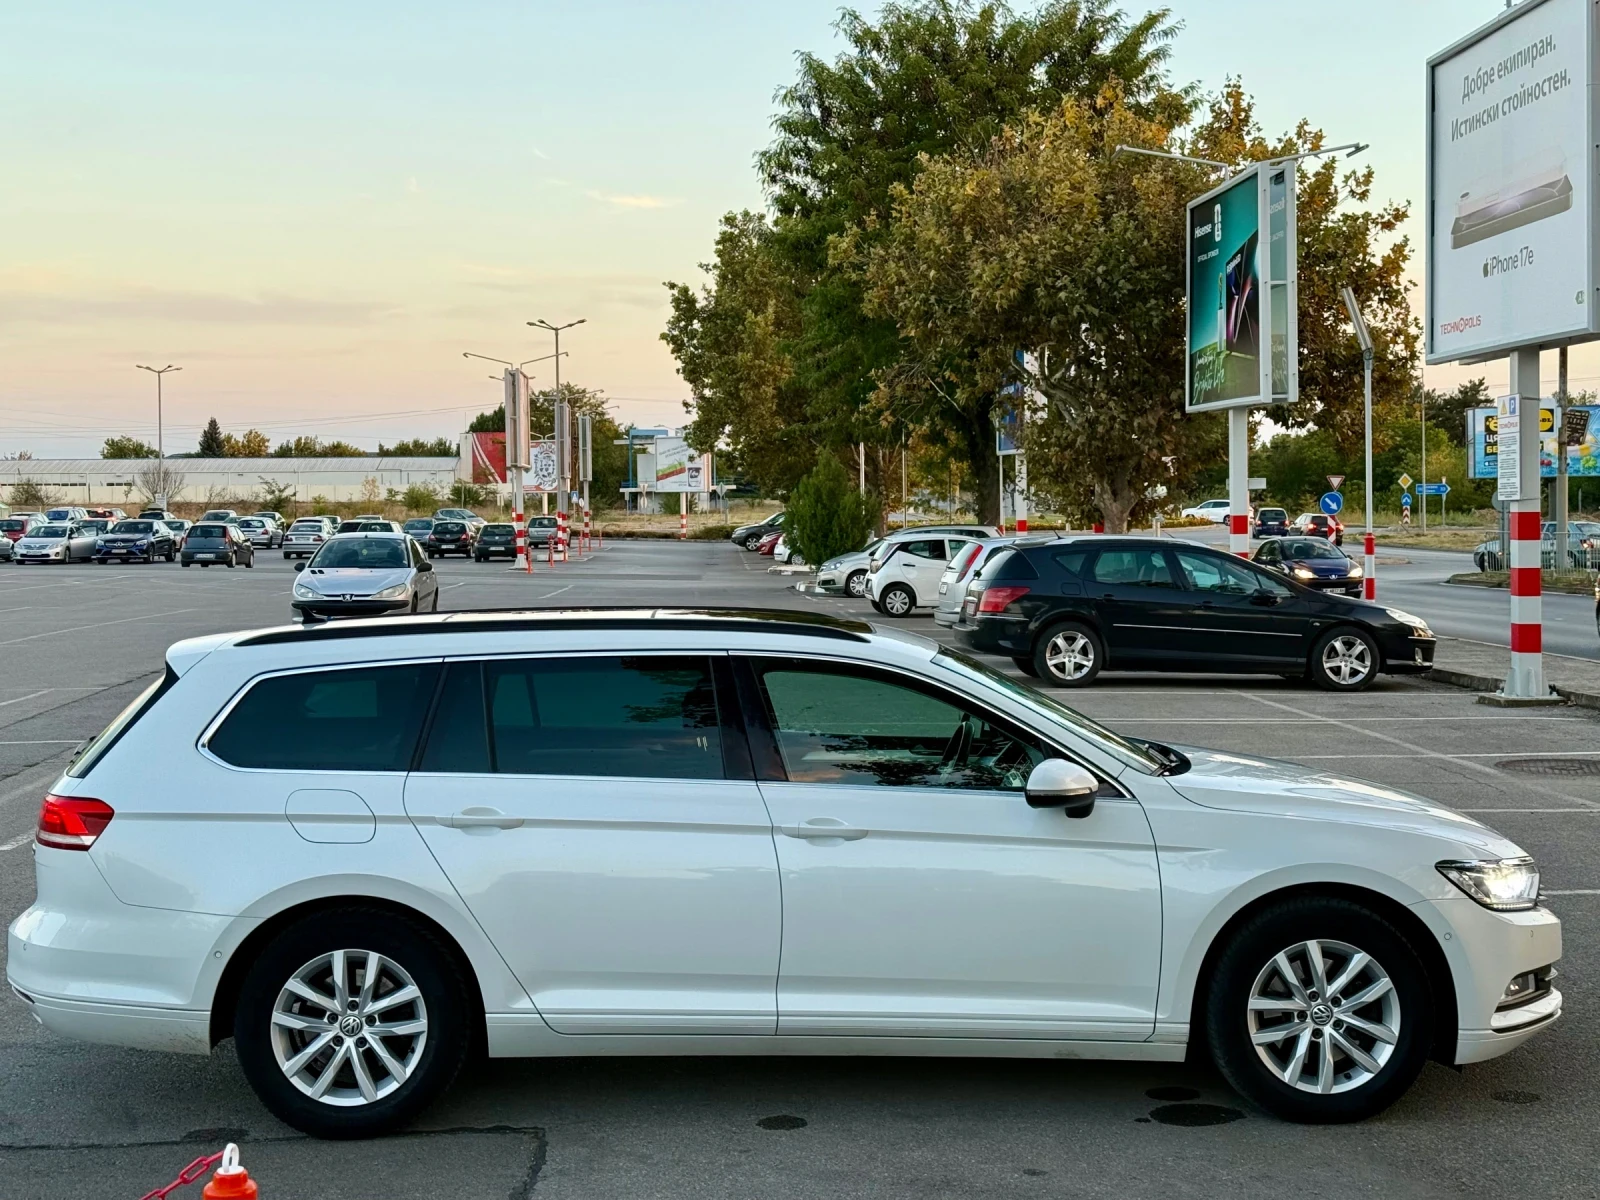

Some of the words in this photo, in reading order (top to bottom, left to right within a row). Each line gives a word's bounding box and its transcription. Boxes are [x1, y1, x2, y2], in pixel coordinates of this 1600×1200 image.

[1462, 66, 1495, 105] Добре
[1497, 34, 1556, 80] екипиран.
[1451, 103, 1499, 142] Истински
[1501, 68, 1571, 117] стойностен.
[1194, 223, 1212, 239] Hisense
[1489, 254, 1519, 277] iPhone
[1519, 246, 1534, 267] 17e
[1440, 315, 1482, 335] TECHNOPOLIS
